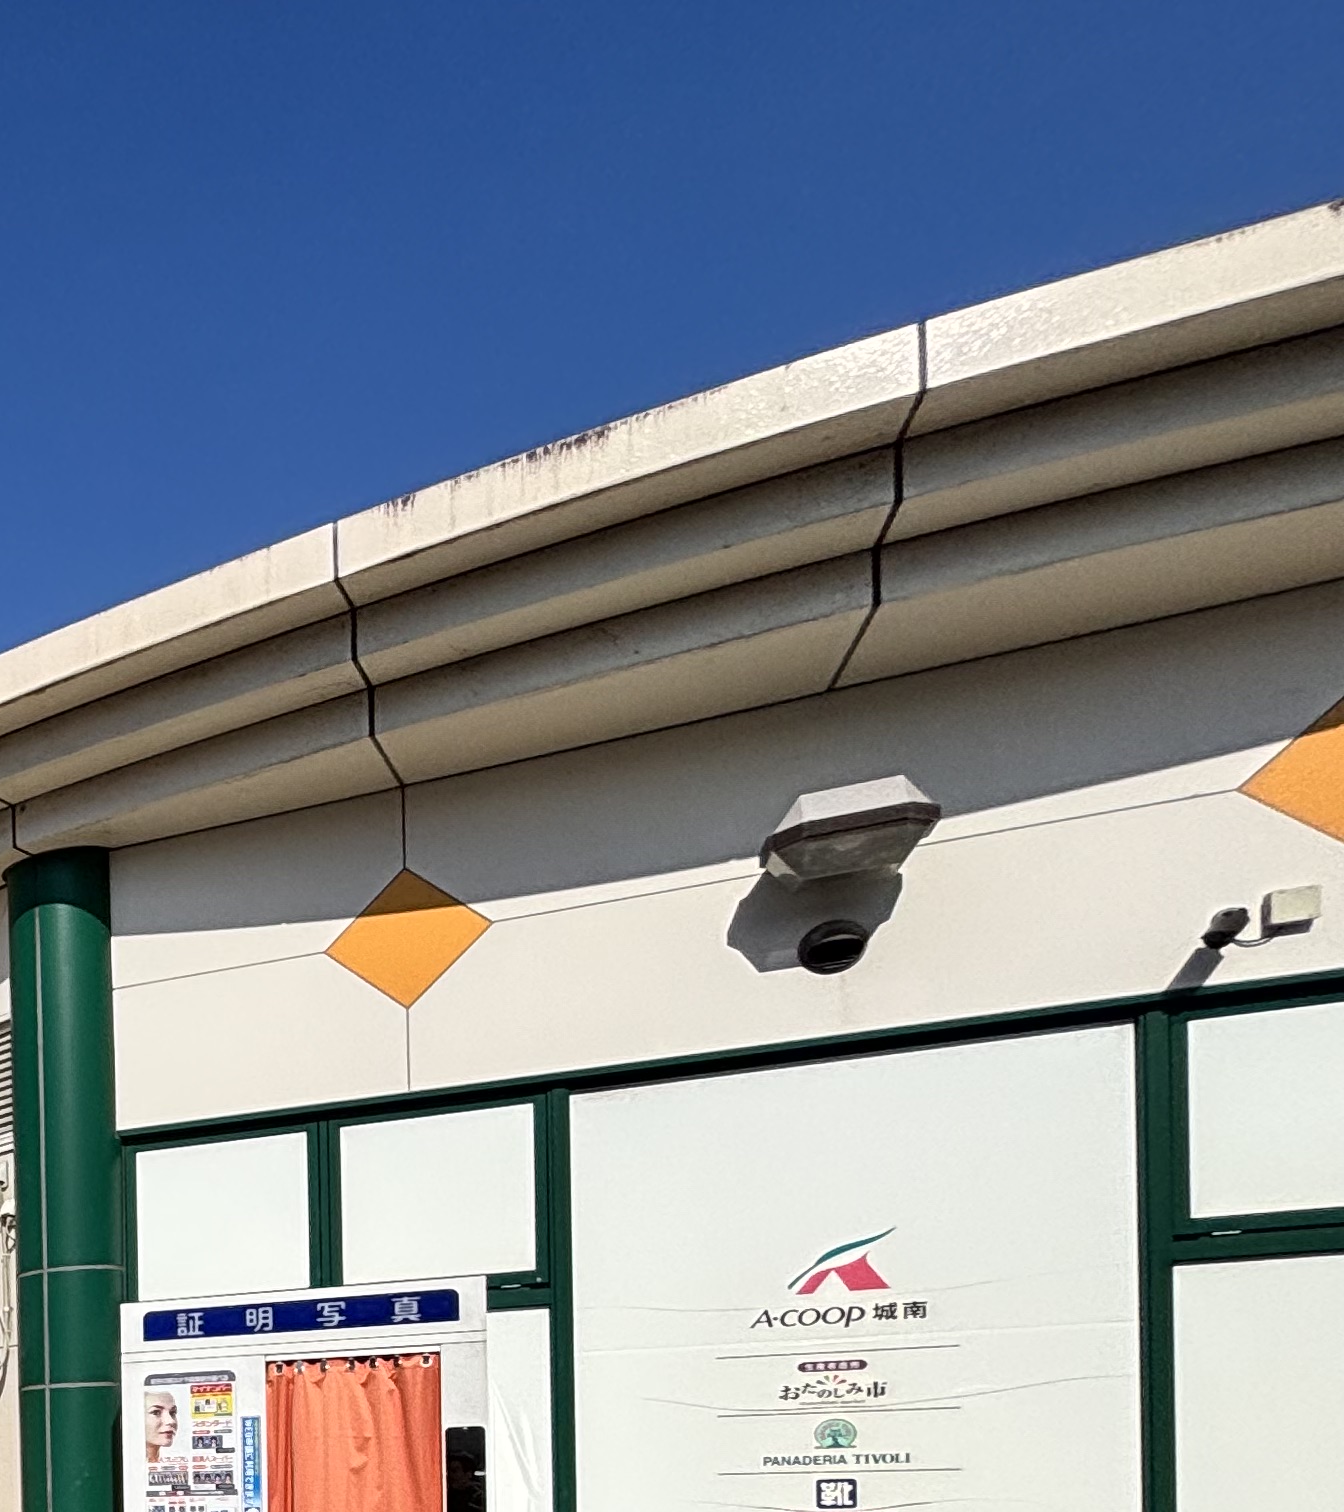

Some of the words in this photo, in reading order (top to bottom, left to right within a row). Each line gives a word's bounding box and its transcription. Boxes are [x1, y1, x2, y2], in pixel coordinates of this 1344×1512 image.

[176, 1296, 422, 1338] 証明写真
[872, 1301, 928, 1320] 城南
[778, 1380, 888, 1401] おたのしみ市
[762, 1454, 848, 1467] PANADERIA
[852, 1452, 911, 1465] TIVOLI
